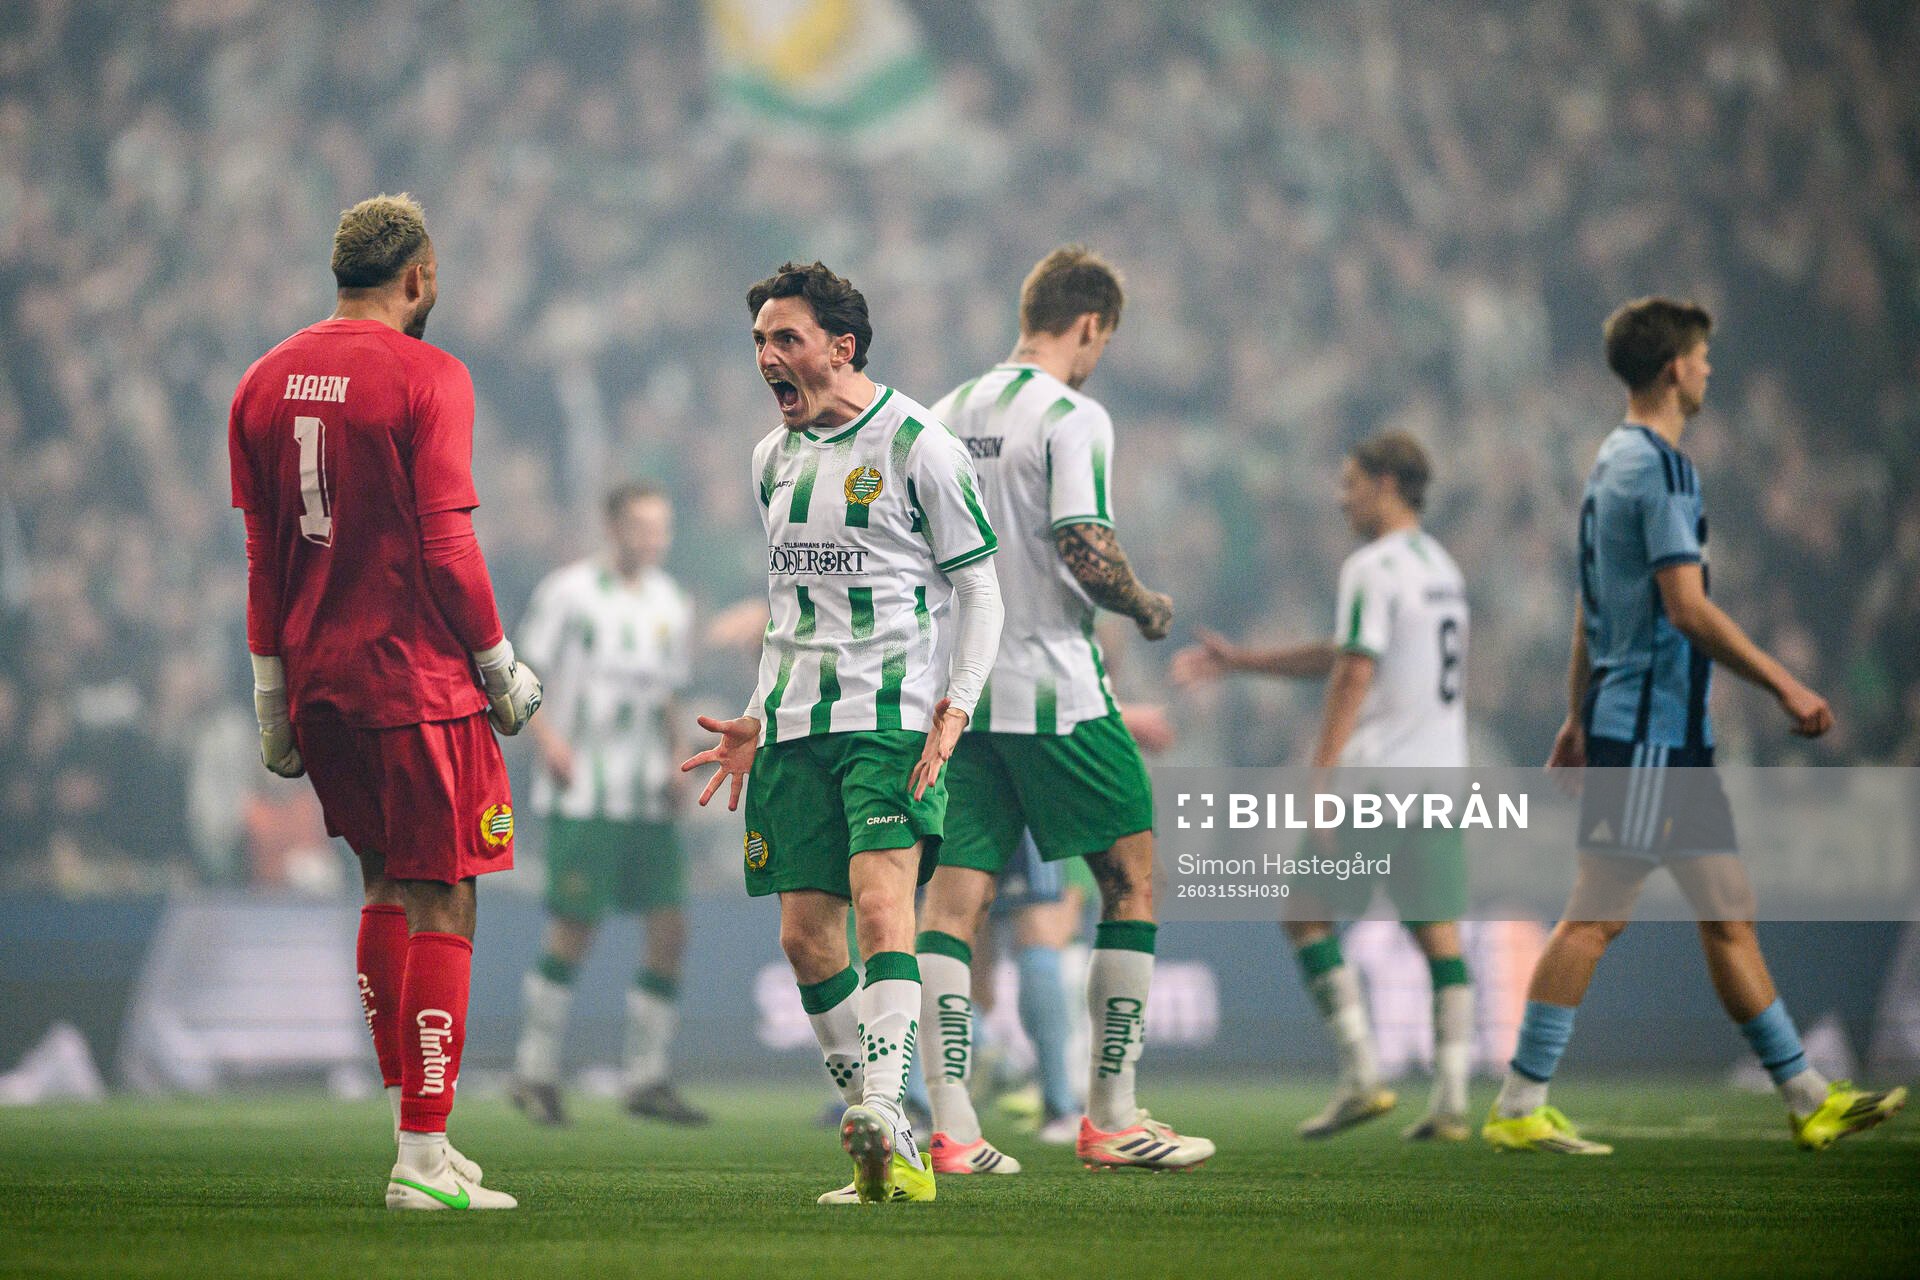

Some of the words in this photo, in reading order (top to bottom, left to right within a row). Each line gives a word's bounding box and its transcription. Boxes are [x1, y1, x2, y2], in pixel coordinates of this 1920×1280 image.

[283, 374, 350, 403] HAHN
[293, 416, 332, 548] 1
[821, 541, 835, 549] FÖR
[866, 815, 900, 825] CRAFT
